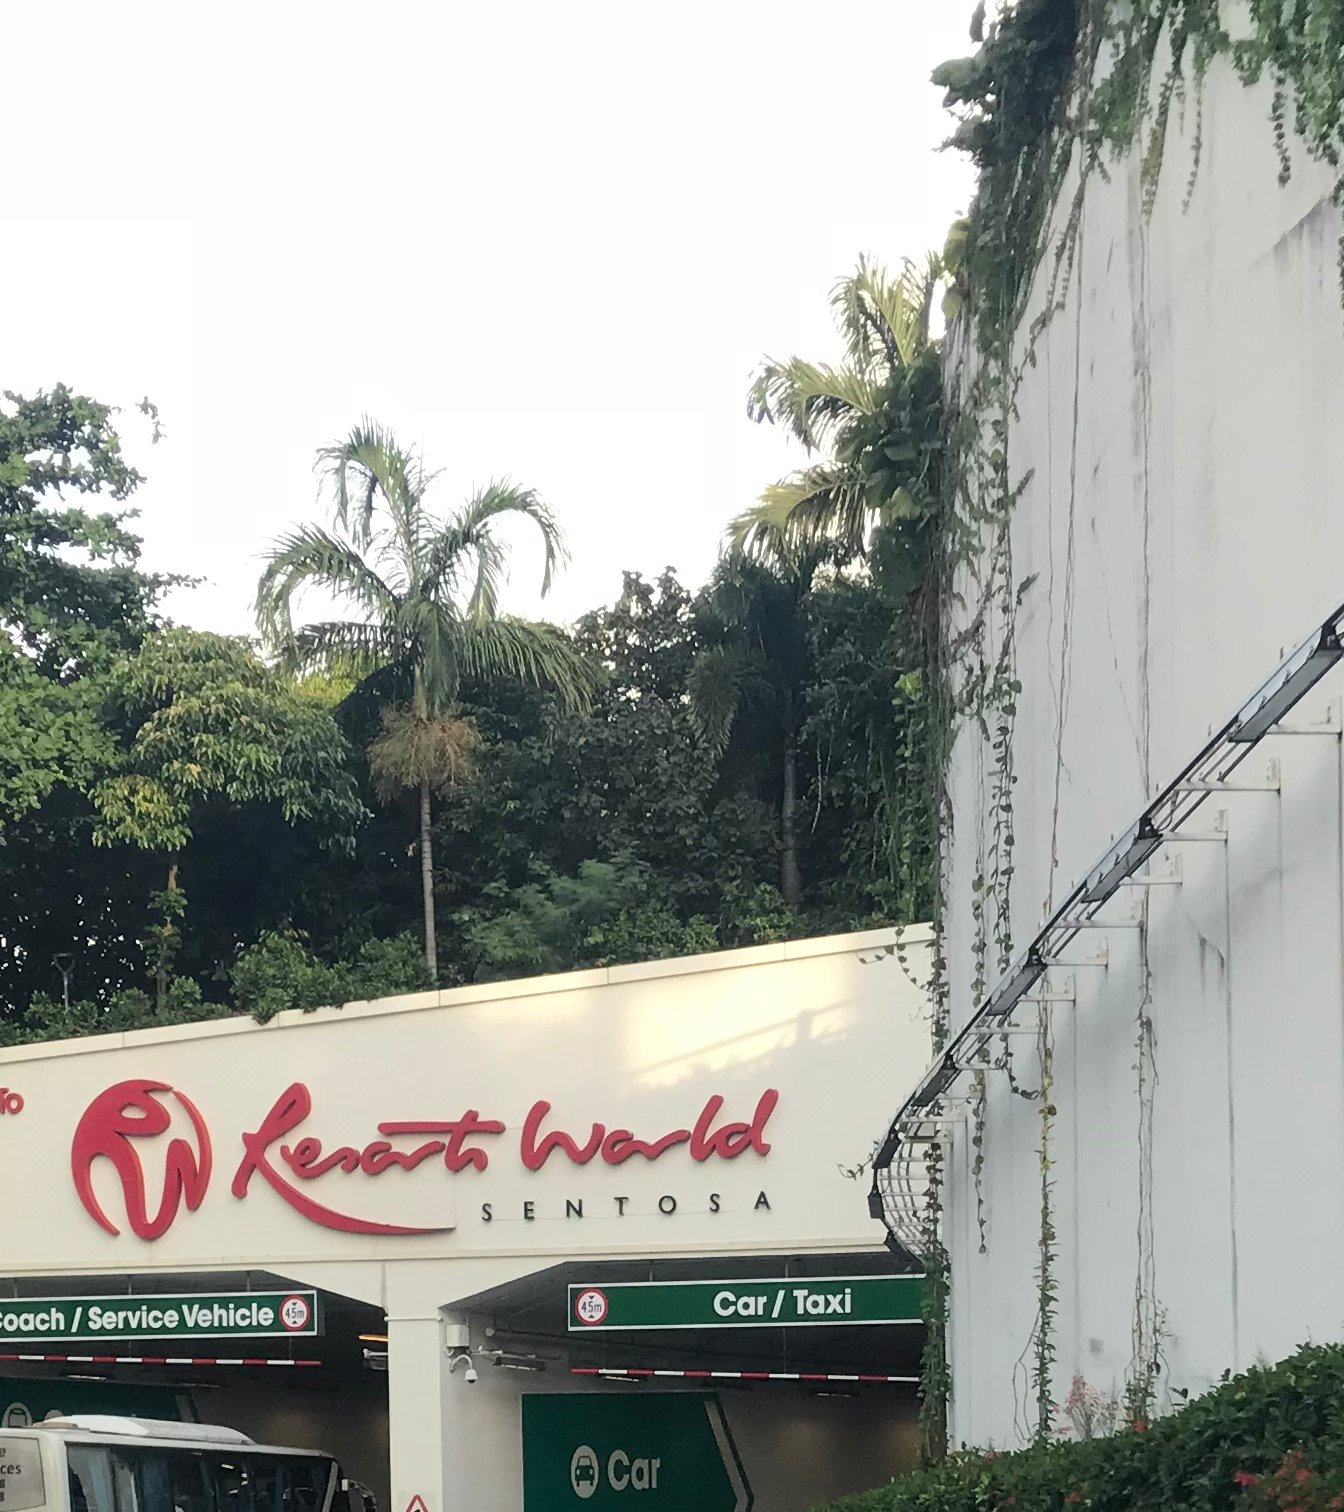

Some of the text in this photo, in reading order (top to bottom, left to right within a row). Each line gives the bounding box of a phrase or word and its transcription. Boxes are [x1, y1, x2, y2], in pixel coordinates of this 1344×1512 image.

[231, 1081, 779, 1235] Resorts World
[481, 1191, 772, 1223] SENTOSA
[70, 1307, 83, 1333] /
[88, 1305, 179, 1331] Service
[182, 1303, 275, 1328] Vehicle
[713, 1288, 852, 1318] Car / Taxi
[607, 1449, 661, 1491] Car
